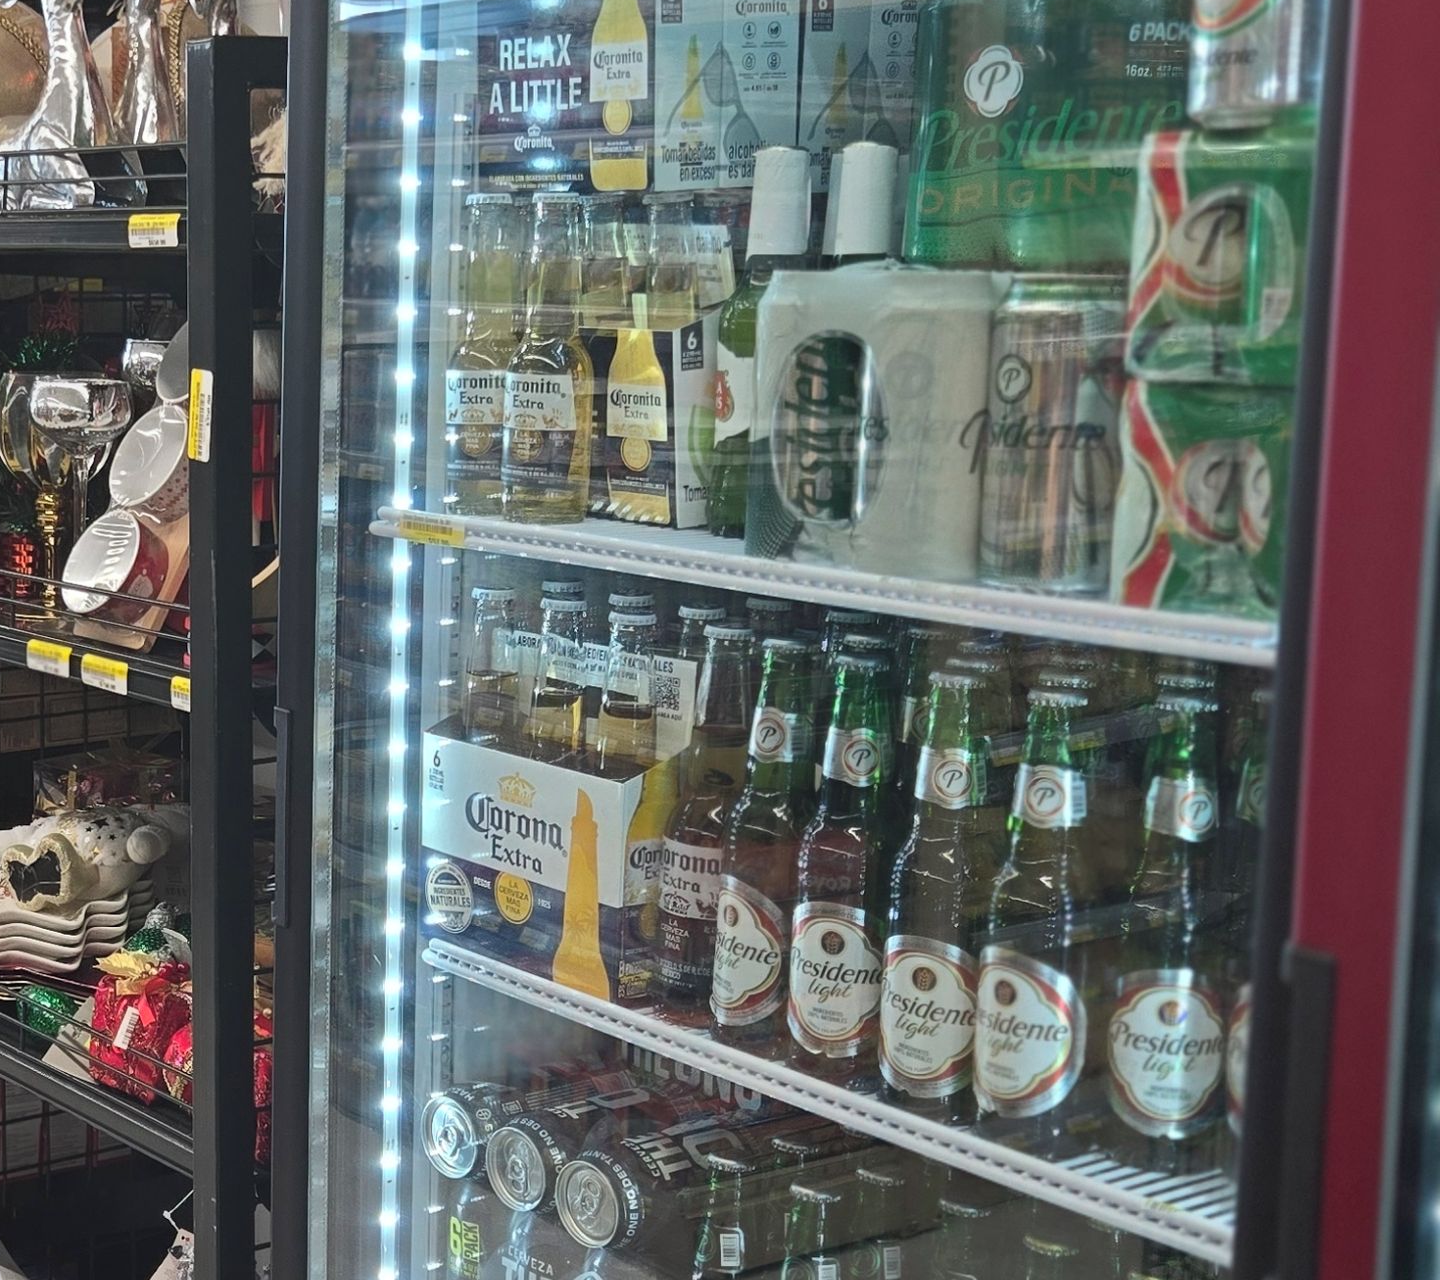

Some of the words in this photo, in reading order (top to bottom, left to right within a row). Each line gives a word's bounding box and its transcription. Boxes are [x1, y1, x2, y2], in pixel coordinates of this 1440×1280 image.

[736, 0, 789, 16] Coronita
[500, 33, 571, 71] RELAX
[593, 47, 643, 70] Coronita
[606, 63, 631, 81] Extra
[490, 83, 505, 115] A
[510, 77, 582, 114] LITTLE
[515, 135, 555, 152] Coronita
[687, 330, 697, 350] 6
[460, 392, 494, 405] Extra
[512, 395, 544, 410] Extra
[610, 388, 662, 409] Coronita
[624, 406, 649, 419] Extra
[433, 750, 440, 767] 6
[465, 792, 563, 851] Corona
[491, 833, 543, 875] Extra
[473, 876, 492, 889] DESDE
[509, 879, 518, 889] LA
[663, 872, 701, 894] Extra
[430, 896, 471, 908] NATURALES
[499, 885, 529, 902] CERVEZA
[661, 924, 689, 938] CERVEZA
[669, 919, 678, 927] LA
[665, 940, 680, 951] FINA
[807, 979, 853, 1005] light
[895, 1013, 943, 1039] light
